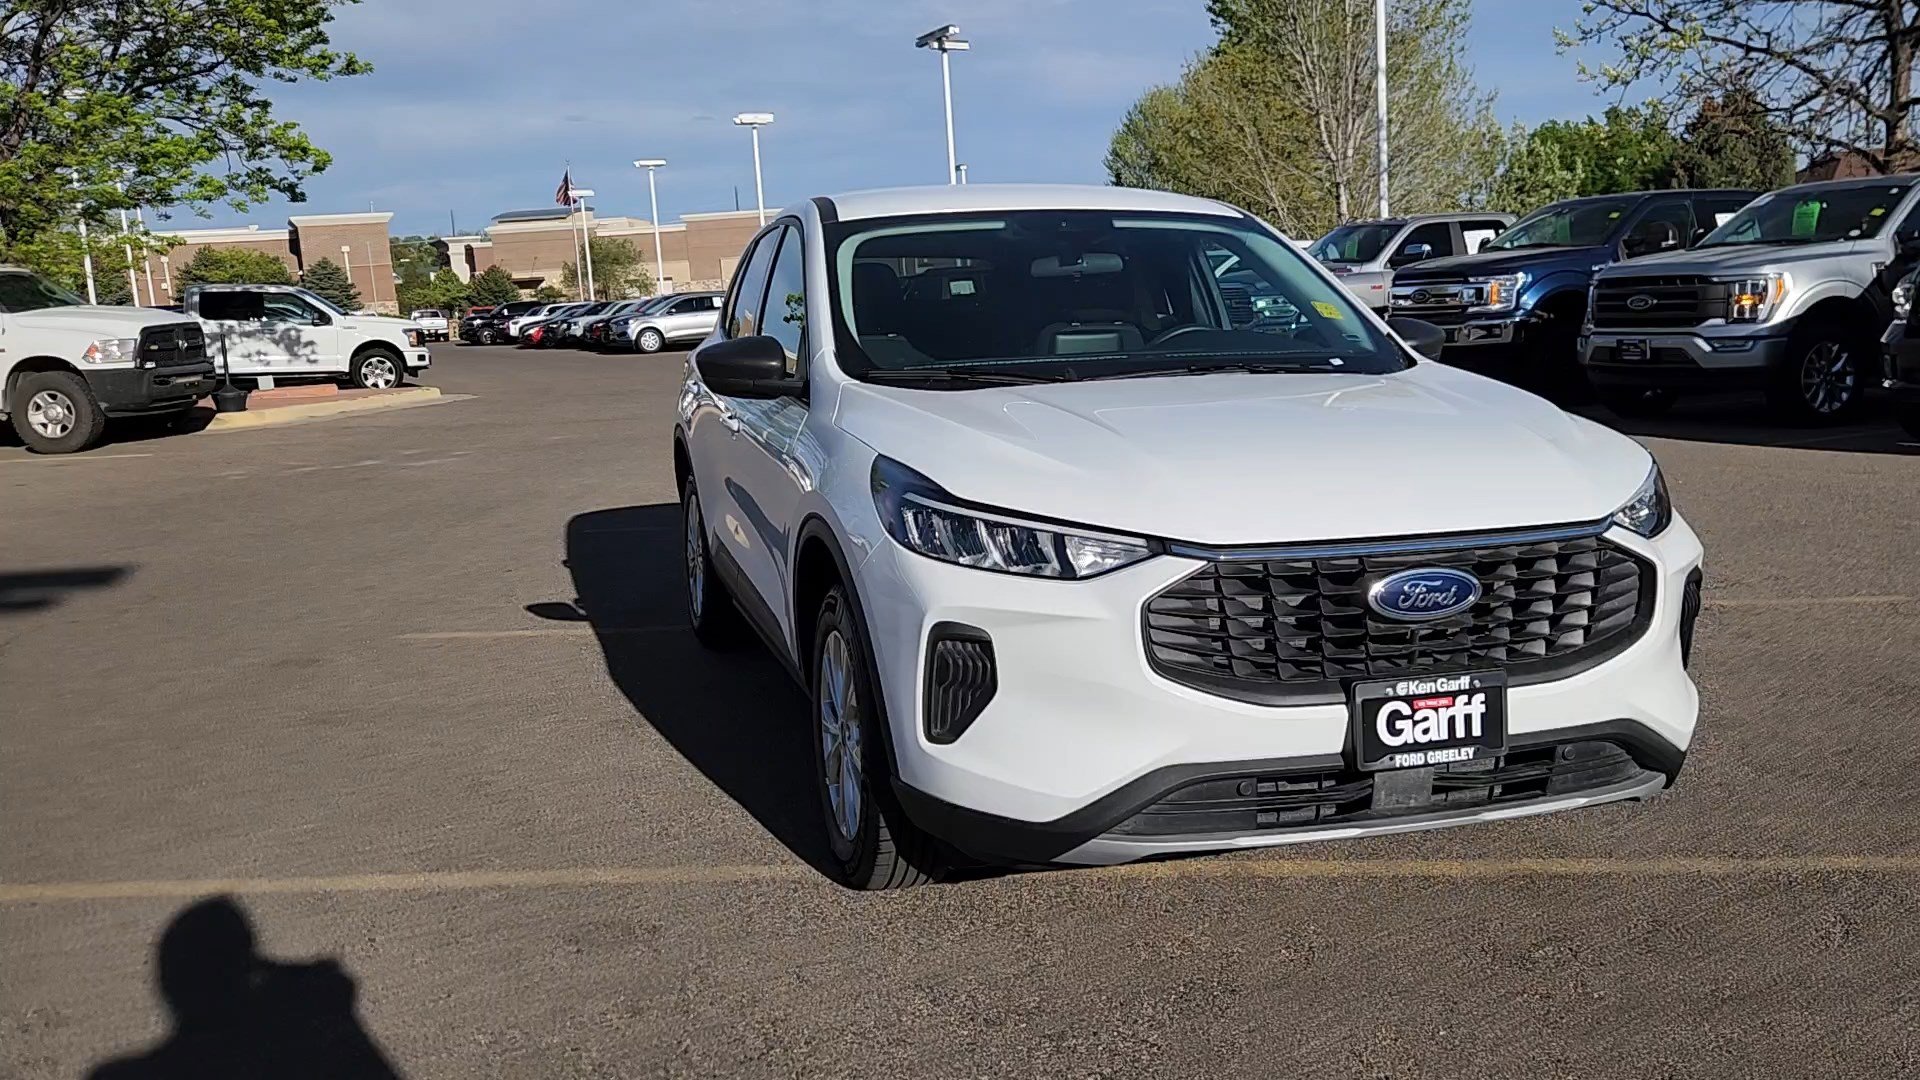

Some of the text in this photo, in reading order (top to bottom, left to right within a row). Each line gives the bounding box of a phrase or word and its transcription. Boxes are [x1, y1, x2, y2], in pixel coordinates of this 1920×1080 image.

[1398, 579, 1459, 609] Ford
[1408, 675, 1471, 695] Ken Garff
[1376, 692, 1487, 747] Garff
[1395, 747, 1475, 767] FORD GREELEY
